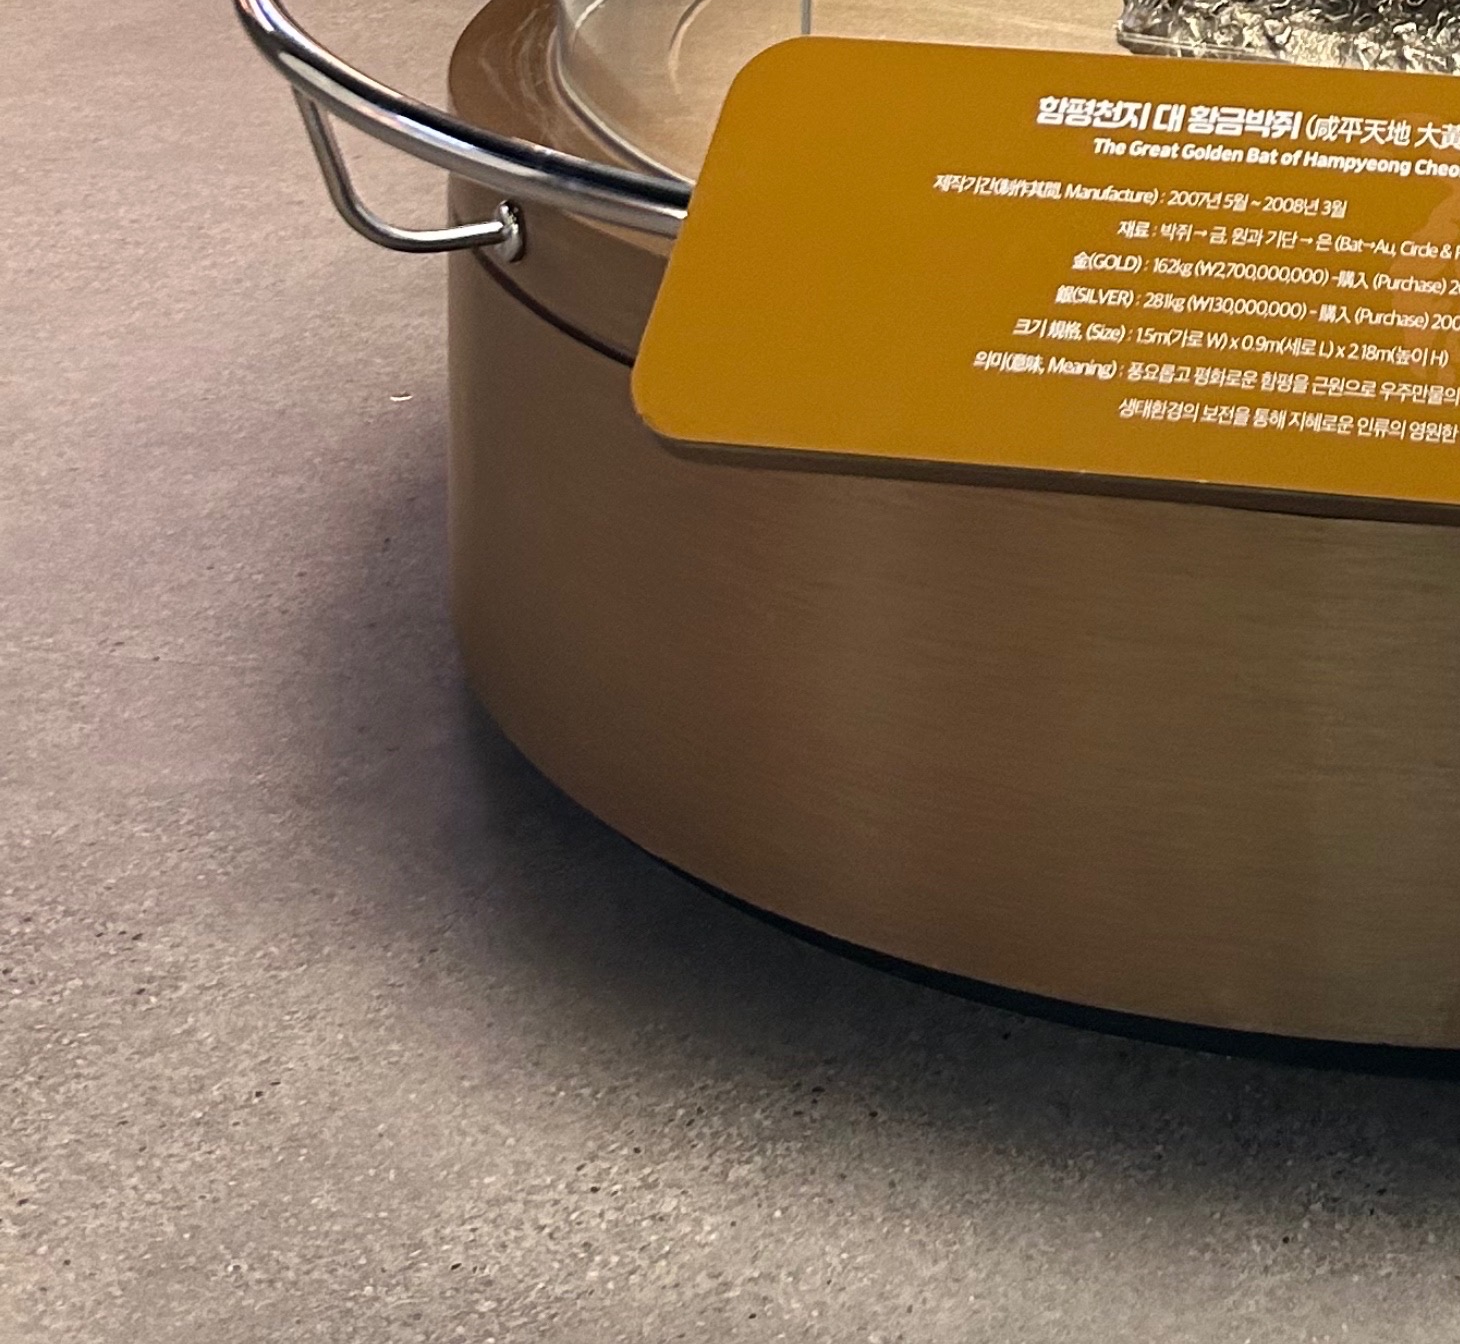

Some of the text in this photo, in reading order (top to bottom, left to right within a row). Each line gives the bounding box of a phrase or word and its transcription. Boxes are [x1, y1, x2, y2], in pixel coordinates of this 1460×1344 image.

[1037, 96, 1151, 130] 함평천지
[1153, 104, 1185, 132] 대
[1188, 106, 1302, 139] 황금박쥐
[1094, 138, 1126, 155] The
[1129, 141, 1179, 158] Great
[1182, 144, 1243, 162] Golden
[1246, 148, 1278, 164] Bat
[1281, 150, 1303, 166] of
[1303, 152, 1411, 176] Hampyeong
[1065, 184, 1158, 205] Manufacture)
[1168, 191, 1222, 208] 2007년
[1224, 194, 1248, 211] 5월
[1263, 197, 1319, 215] 2008년
[1322, 201, 1346, 218] 3월
[1118, 221, 1149, 238] 재료
[1161, 224, 1192, 241] 박쥐
[1232, 228, 1263, 246] 원과
[1266, 231, 1297, 248] 기단
[1316, 234, 1331, 251] 은
[1401, 241, 1438, 257] Circle
[1440, 244, 1452, 258] &
[1072, 252, 1142, 273] 金(GOLD)
[1154, 258, 1193, 277] 162kg
[1373, 274, 1446, 295] (Purchase)
[1355, 308, 1429, 329] (Purchase)
[1014, 319, 1047, 337] 크기
[1086, 323, 1125, 343] (Size)
[1208, 333, 1227, 349] W)
[1229, 338, 1239, 349] x
[1242, 335, 1316, 356] 0.9m(세로
[1319, 341, 1333, 358] L)
[1336, 346, 1345, 357] x
[1431, 351, 1448, 367] H)
[1048, 357, 1116, 379] Meaning)
[1128, 362, 1190, 383] 풍요롭고
[1194, 368, 1257, 388] 평화로운
[1262, 372, 1308, 393] 함평을
[1313, 377, 1376, 397] 근원으로
[1380, 382, 1460, 405] 우주만물의
[1201, 406, 1249, 426] 보전을
[1254, 409, 1286, 429] 통해
[1289, 412, 1353, 434] 지혜로운
[1358, 418, 1406, 439] 인류의
[1410, 422, 1458, 442] 영원한
